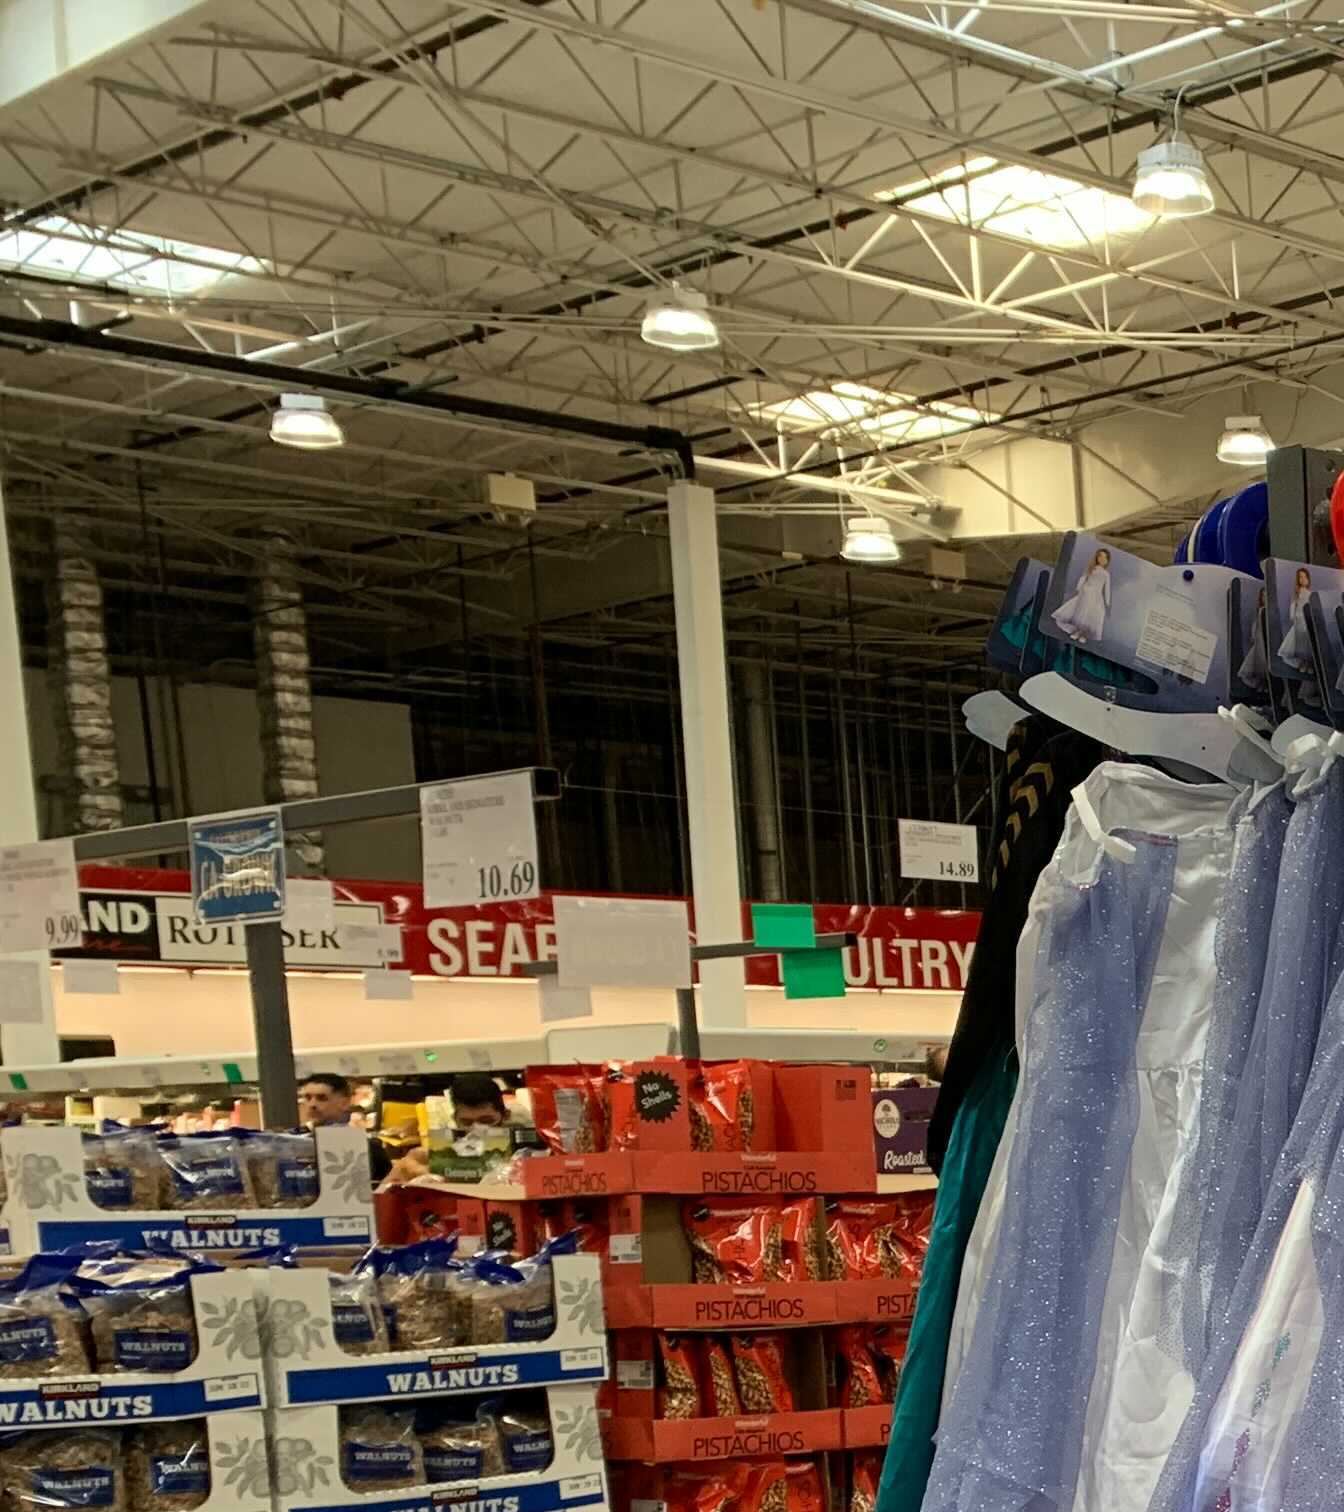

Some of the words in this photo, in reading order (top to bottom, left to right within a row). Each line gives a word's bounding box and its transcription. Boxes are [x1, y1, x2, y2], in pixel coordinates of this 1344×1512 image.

[478, 861, 536, 899] 10.69
[939, 861, 975, 877] 14.89
[45, 915, 79, 944] 9.99
[642, 1081, 661, 1096] No
[640, 1090, 673, 1111] Shells
[884, 1150, 926, 1171] Roasted
[542, 1172, 608, 1195] PISTACHIOS
[702, 1171, 817, 1193] PISTACHIOS
[142, 1228, 281, 1250] WALNUTS
[696, 1299, 804, 1322] PISTACHIOS
[121, 1341, 186, 1352] WALNUTS
[387, 1363, 520, 1393] WALNUTS
[693, 1430, 805, 1458] PISTACHIOS
[355, 1451, 411, 1462] WALNUTS
[42, 1476, 111, 1490] WALNUTS
